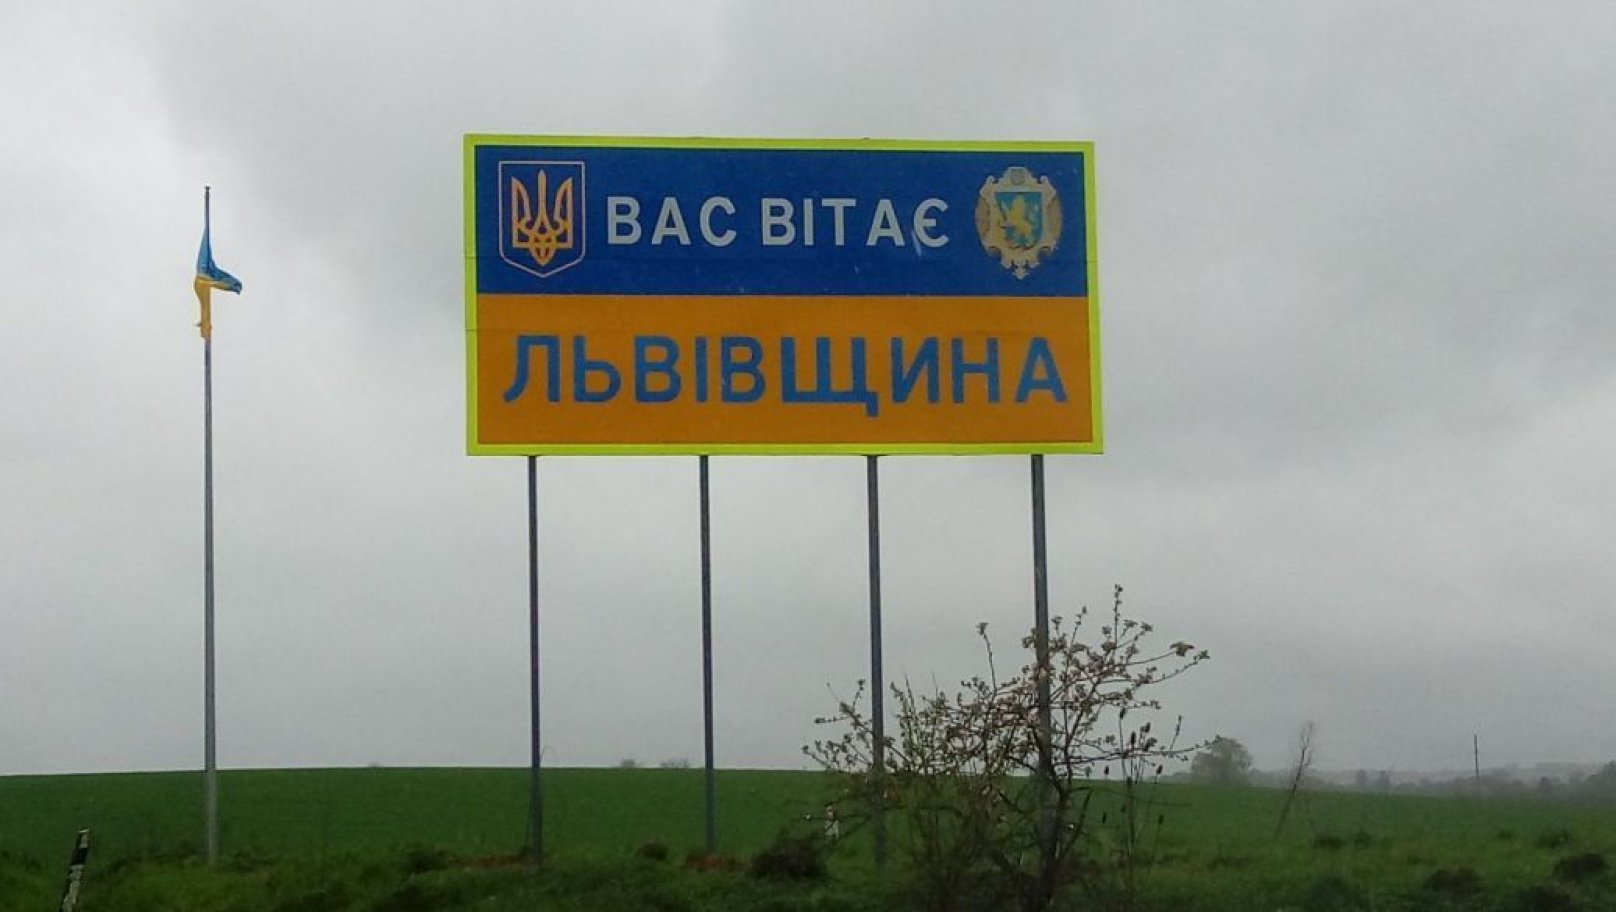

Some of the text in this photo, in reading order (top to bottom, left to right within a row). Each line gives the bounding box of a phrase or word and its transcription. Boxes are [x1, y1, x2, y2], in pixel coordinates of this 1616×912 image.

[606, 196, 950, 248] ВАС ВІТАЄ
[503, 334, 1068, 417] ЛЬВІВЩИНА
